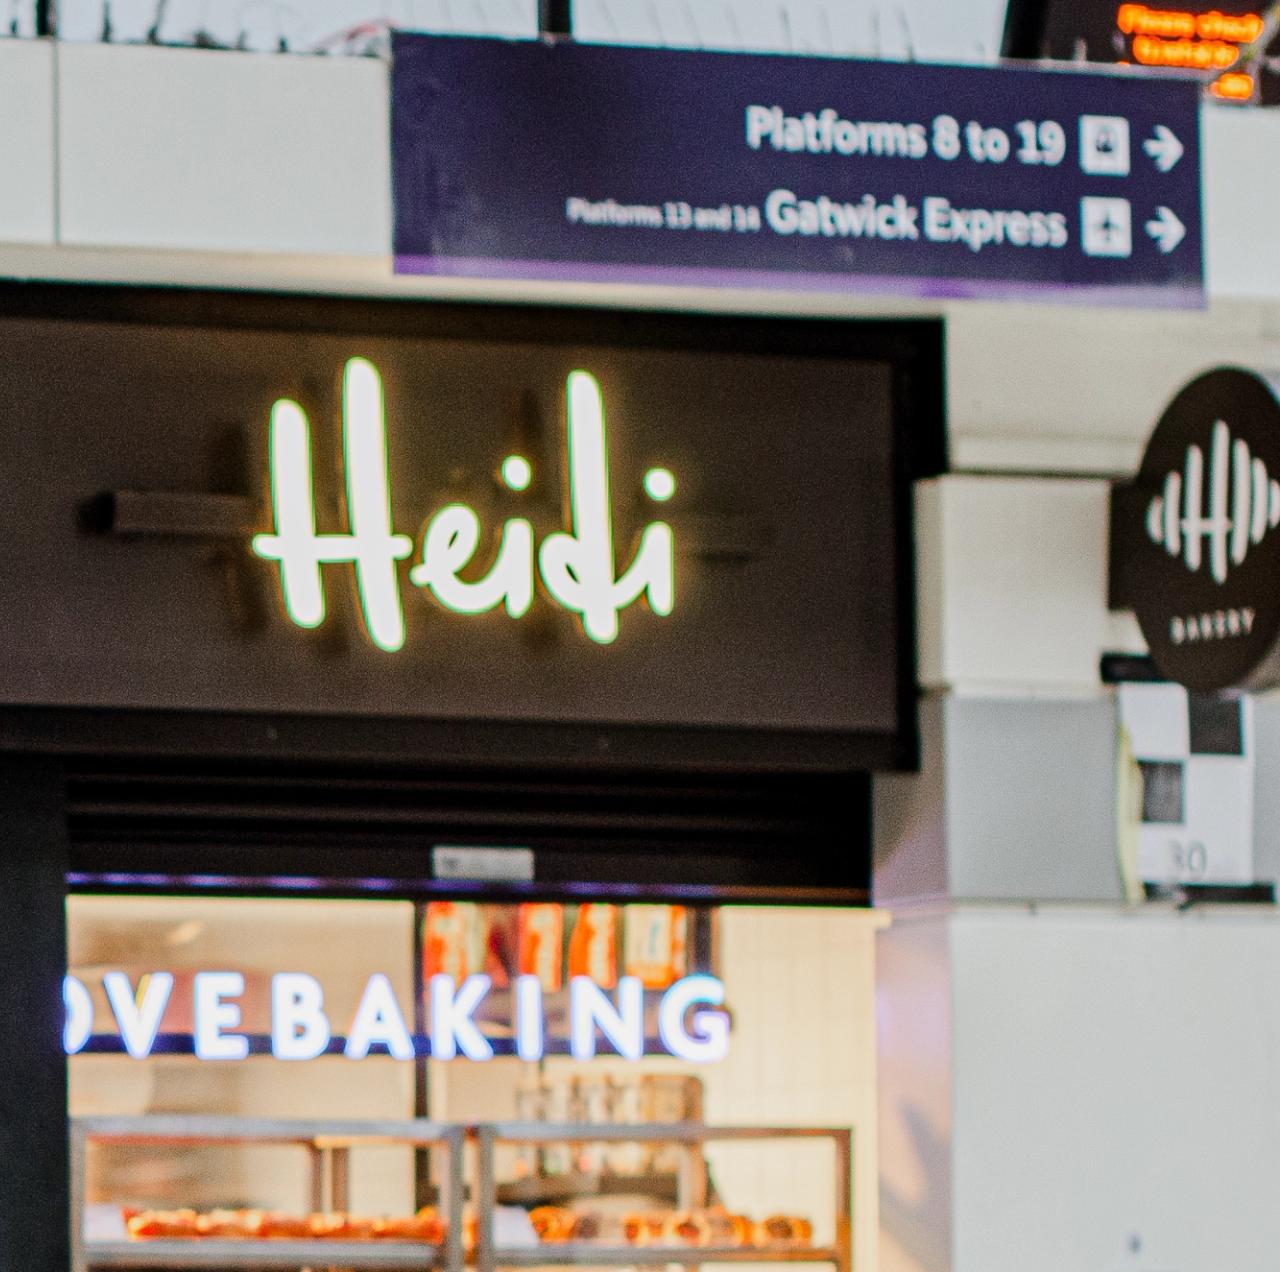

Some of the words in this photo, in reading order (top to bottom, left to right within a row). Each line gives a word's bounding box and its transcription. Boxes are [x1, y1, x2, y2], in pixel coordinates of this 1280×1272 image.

[745, 104, 928, 159] Platforms
[932, 114, 961, 160] 8
[965, 120, 1010, 163] to
[1015, 119, 1067, 166] 19
[566, 196, 664, 229] Platforms
[765, 188, 919, 241] Gatwick
[922, 196, 1069, 252] Express
[251, 356, 677, 653] Heidi
